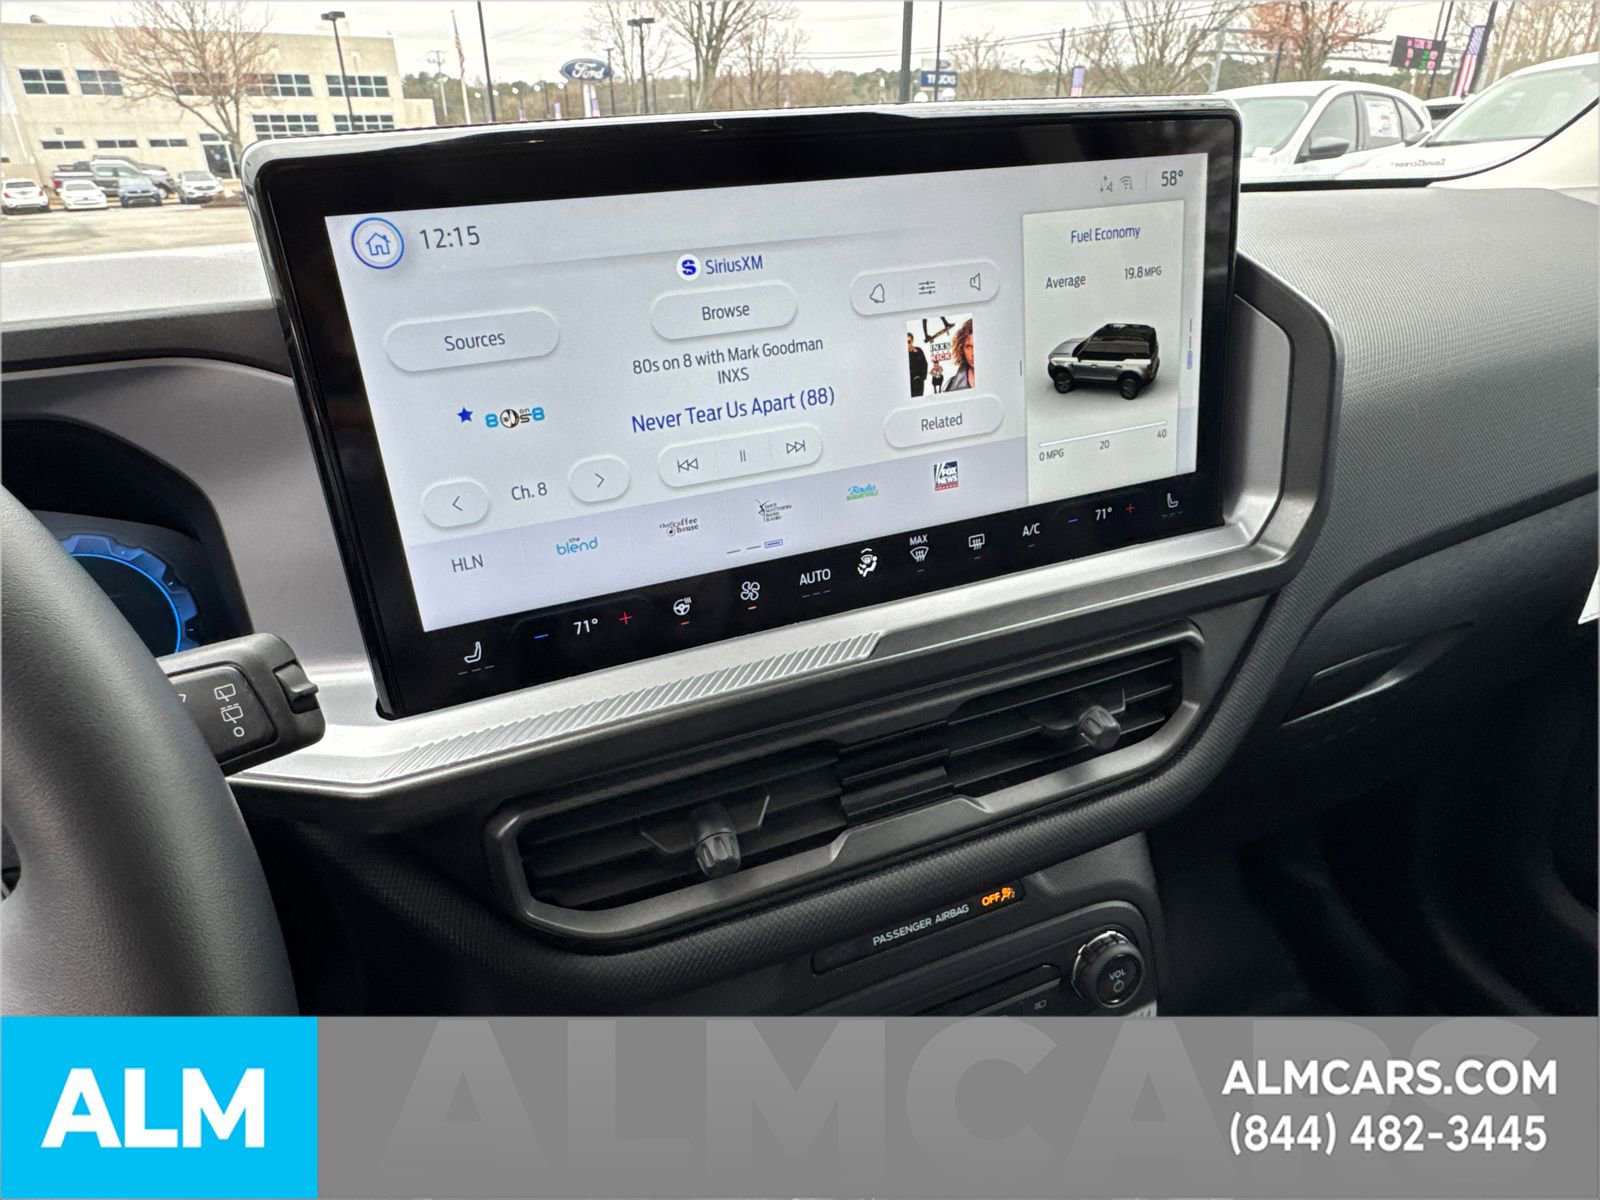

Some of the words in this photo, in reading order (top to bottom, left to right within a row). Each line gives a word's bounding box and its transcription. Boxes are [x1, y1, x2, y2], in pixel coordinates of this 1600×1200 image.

[572, 62, 606, 79] Ford
[419, 225, 481, 250] 12:15
[1071, 229, 1093, 243] Fuel
[1095, 226, 1141, 242] Economy
[705, 255, 764, 275] SiriusXM
[1045, 275, 1086, 290] Average
[702, 303, 750, 321] Browse
[444, 331, 506, 352] Sources
[632, 358, 660, 375] 80s
[662, 356, 680, 371] on
[683, 353, 692, 368] 8
[695, 350, 726, 367] with
[727, 346, 760, 363] Mark
[762, 338, 824, 358] Goodman
[717, 367, 750, 385] INXS
[632, 411, 682, 434] Never
[685, 405, 723, 425] Tear
[726, 401, 748, 419] Us
[751, 391, 796, 417] Apart
[800, 386, 836, 411] (88)
[921, 413, 963, 432] Related
[1156, 428, 1168, 439] 40
[1099, 439, 1110, 450] 20
[1039, 451, 1045, 462] 0
[1046, 448, 1065, 460] MPG
[511, 485, 535, 501] Ch.
[537, 482, 548, 496] 8
[676, 524, 699, 534] house
[1022, 522, 1041, 537] A/C
[556, 537, 598, 556] blend
[569, 536, 580, 544] the
[909, 534, 928, 546] MAX
[451, 553, 484, 573] HLN
[799, 568, 832, 586] AUTO
[981, 891, 1001, 907] OFF
[872, 917, 933, 946] PASSENGER
[935, 904, 970, 924] AIRBAG
[1109, 968, 1127, 981] VOL
